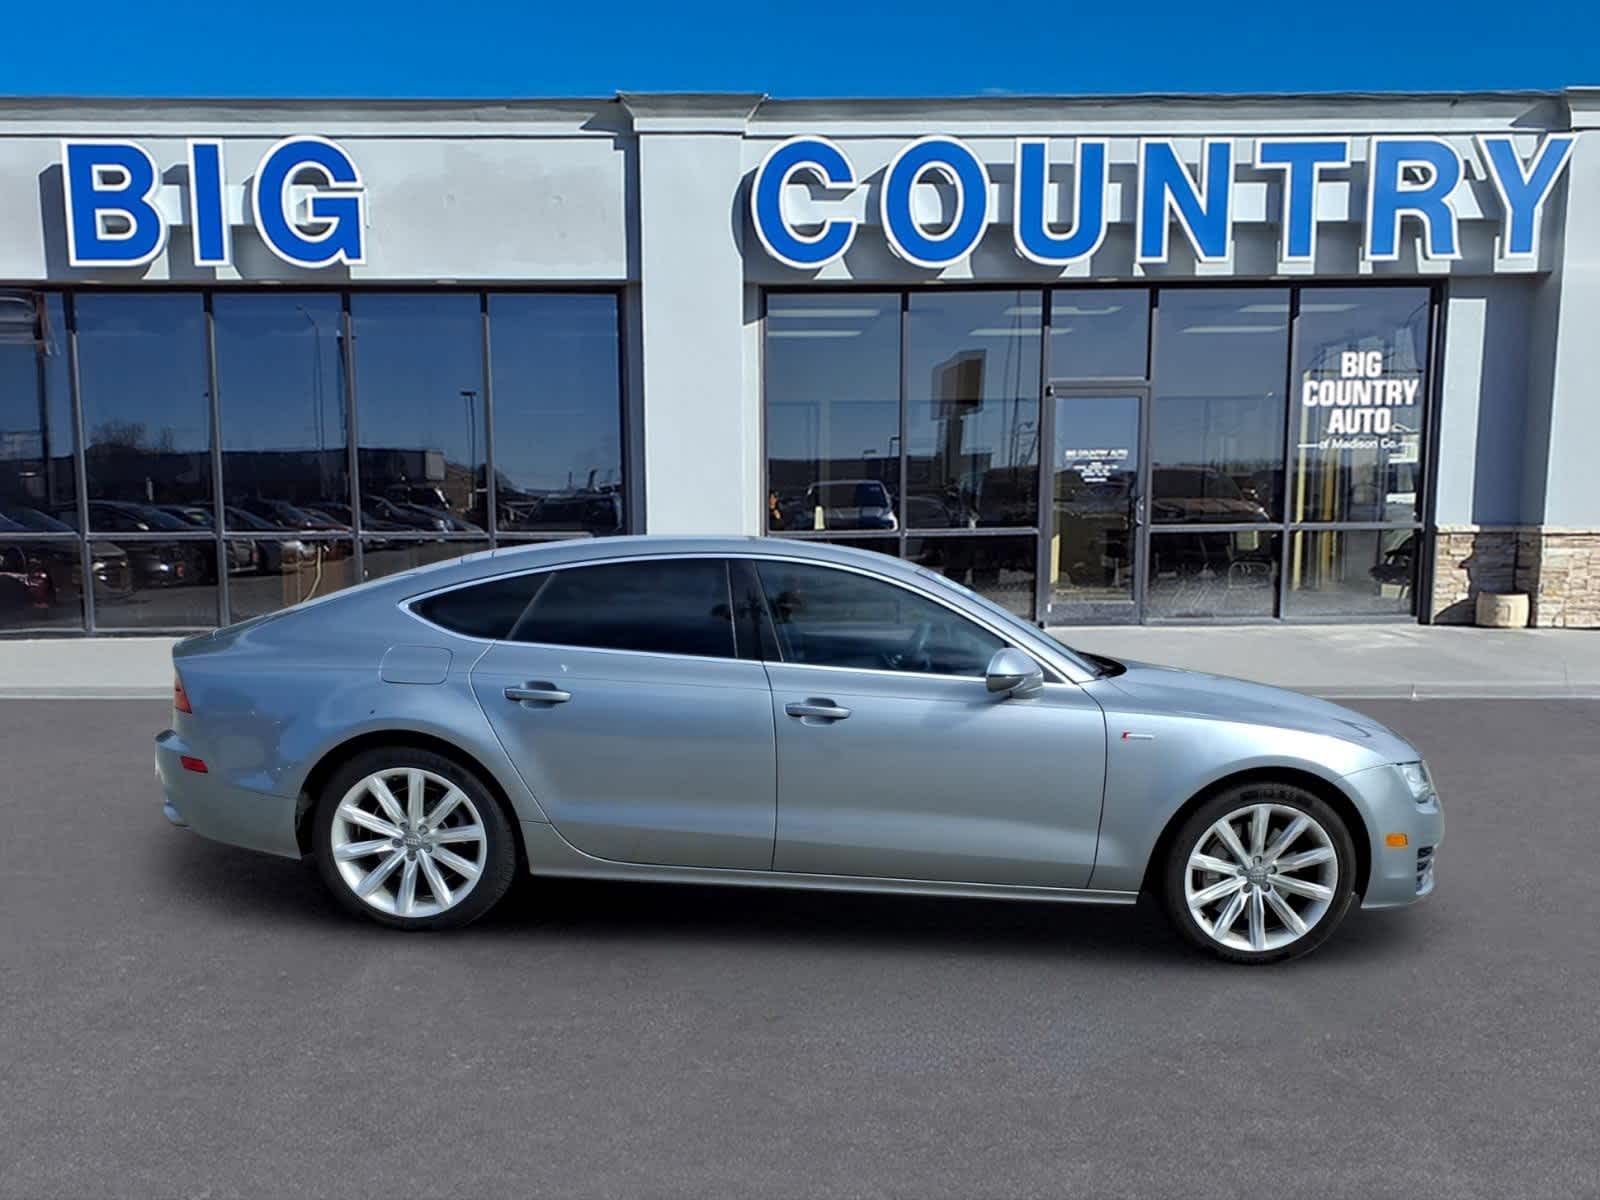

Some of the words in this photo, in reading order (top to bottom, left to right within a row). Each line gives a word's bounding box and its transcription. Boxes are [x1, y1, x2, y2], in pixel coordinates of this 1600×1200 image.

[61, 134, 366, 268] BIG
[751, 133, 1575, 270] COUNTRY
[1341, 351, 1383, 377] BIG
[1303, 379, 1420, 406] COUNTRY
[1328, 407, 1391, 435] AUTO
